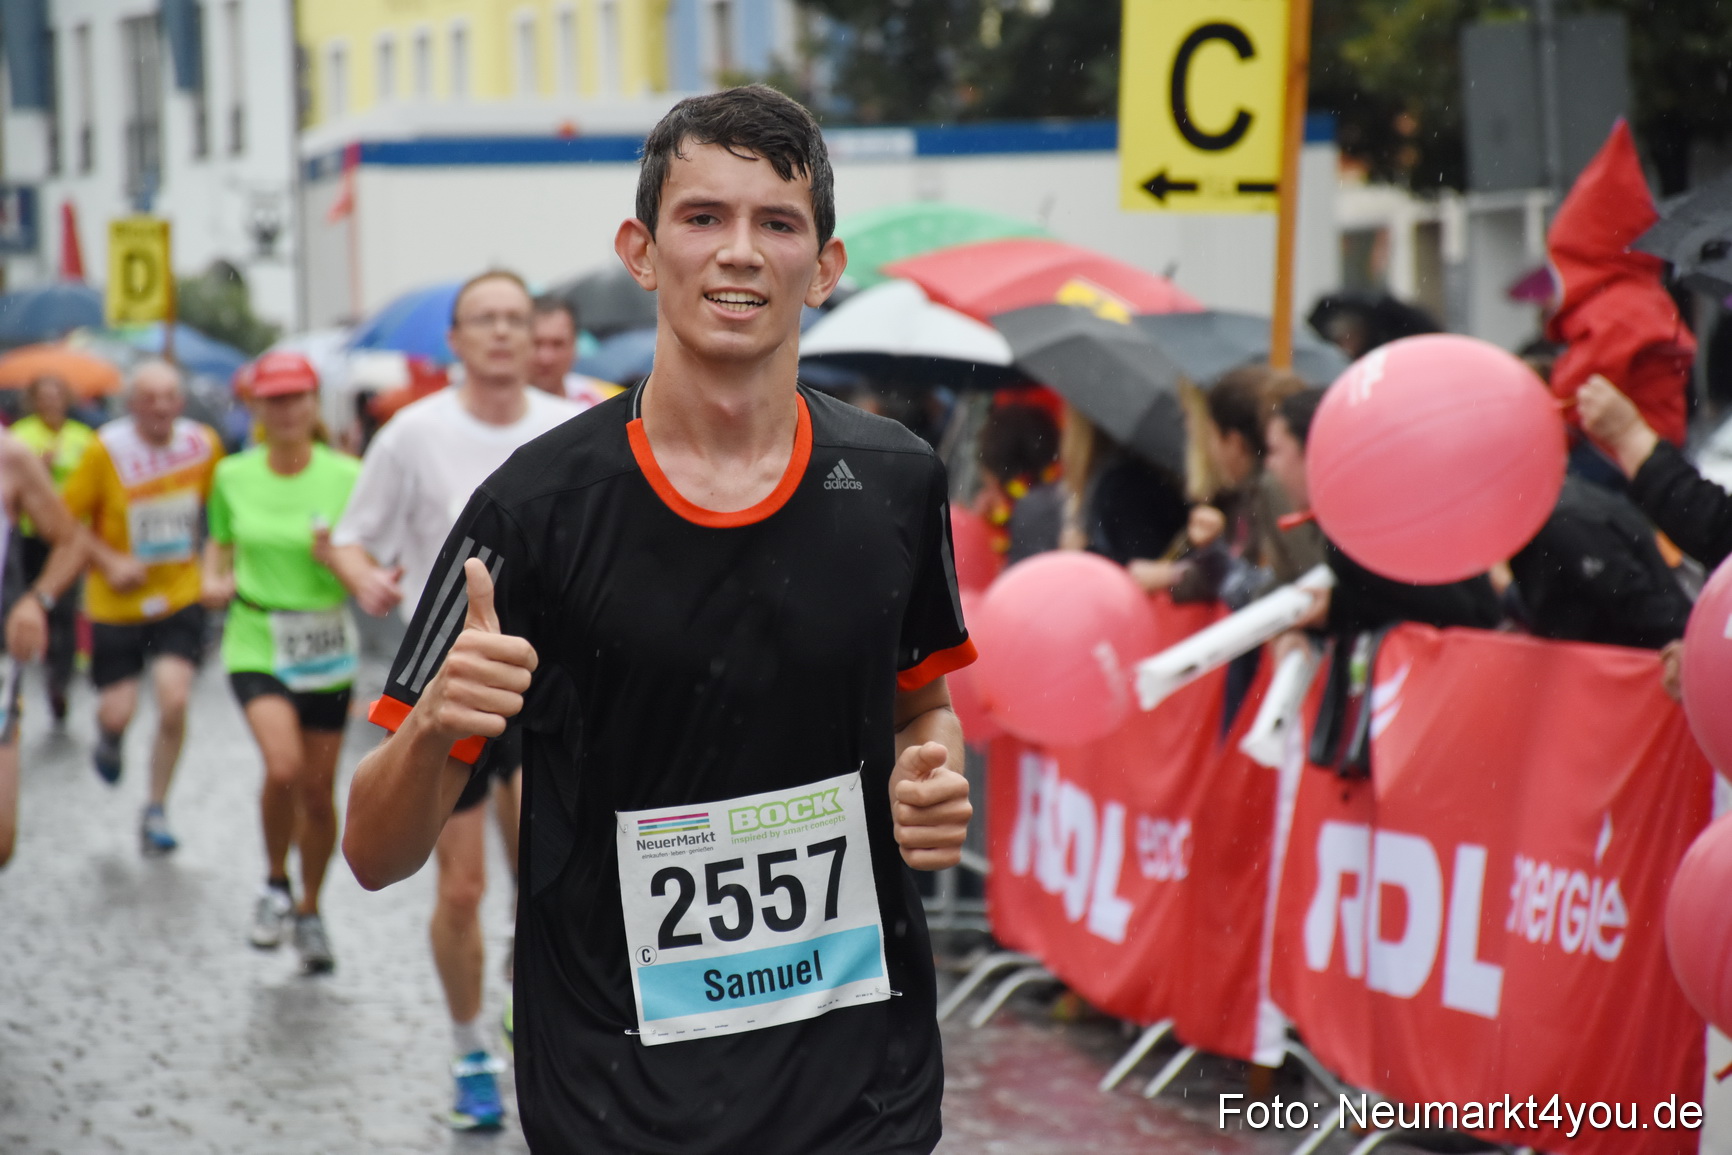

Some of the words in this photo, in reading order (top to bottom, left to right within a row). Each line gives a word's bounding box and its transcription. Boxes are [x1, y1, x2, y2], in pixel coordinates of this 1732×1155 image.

[1170, 22, 1255, 151] C
[122, 249, 157, 302] D
[823, 478, 863, 490] adidas
[728, 787, 844, 835] BOCK
[731, 831, 768, 845] inspired
[770, 829, 781, 840] by
[783, 824, 809, 836] smart
[810, 815, 846, 830] concepts
[636, 831, 716, 851] NeuerMarkt
[650, 835, 848, 950] 2557
[1304, 819, 1504, 1020] RDL
[703, 950, 823, 1002] Samuel
